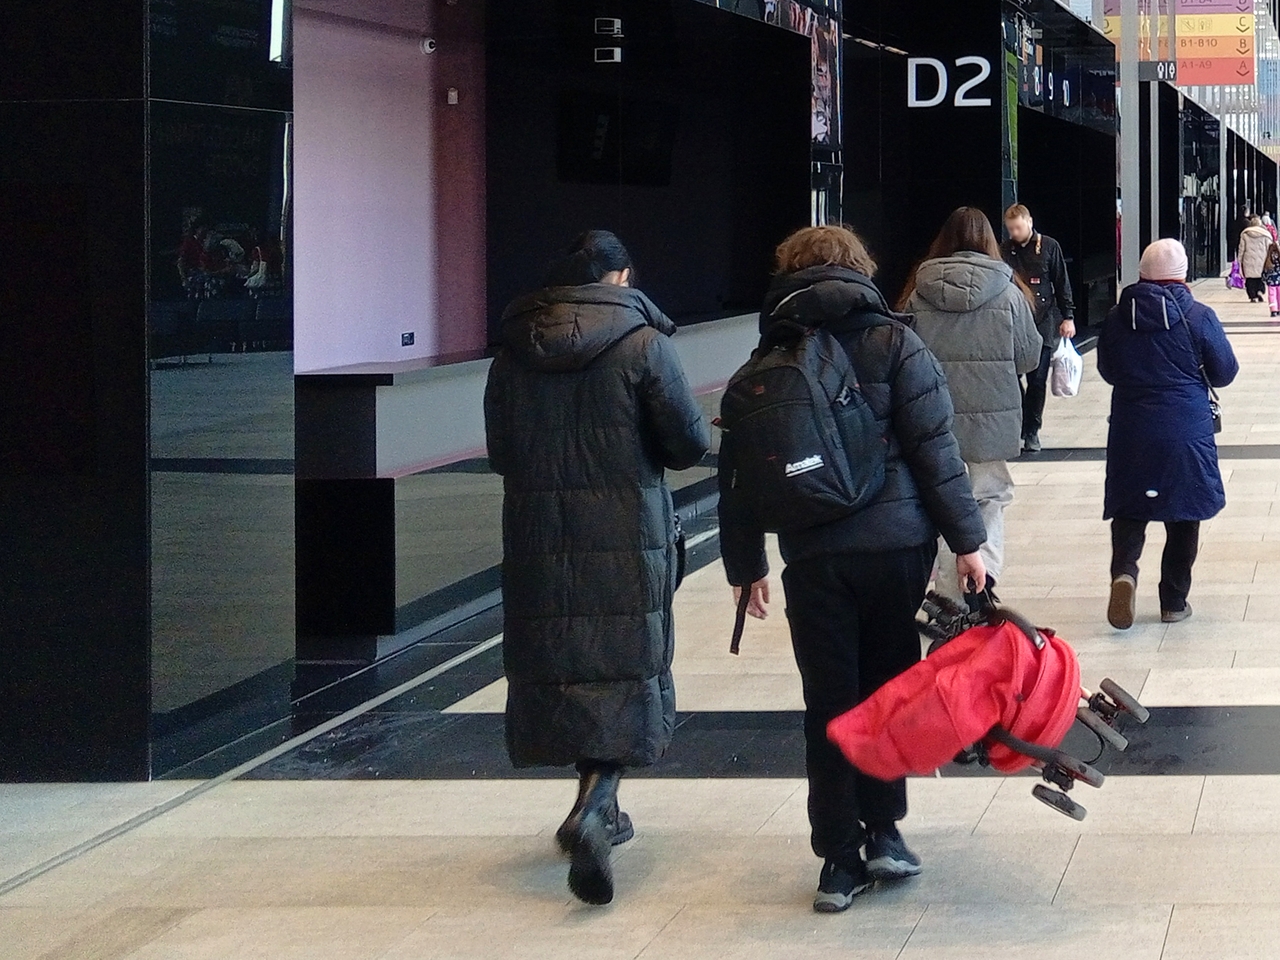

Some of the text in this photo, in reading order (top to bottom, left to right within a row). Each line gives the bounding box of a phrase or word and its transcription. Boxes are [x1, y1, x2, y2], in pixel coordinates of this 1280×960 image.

[1239, 16, 1247, 27] C
[1180, 38, 1247, 49] B1-B10 B
[1181, 60, 1247, 70] A1-A9 A
[907, 55, 992, 109] D2
